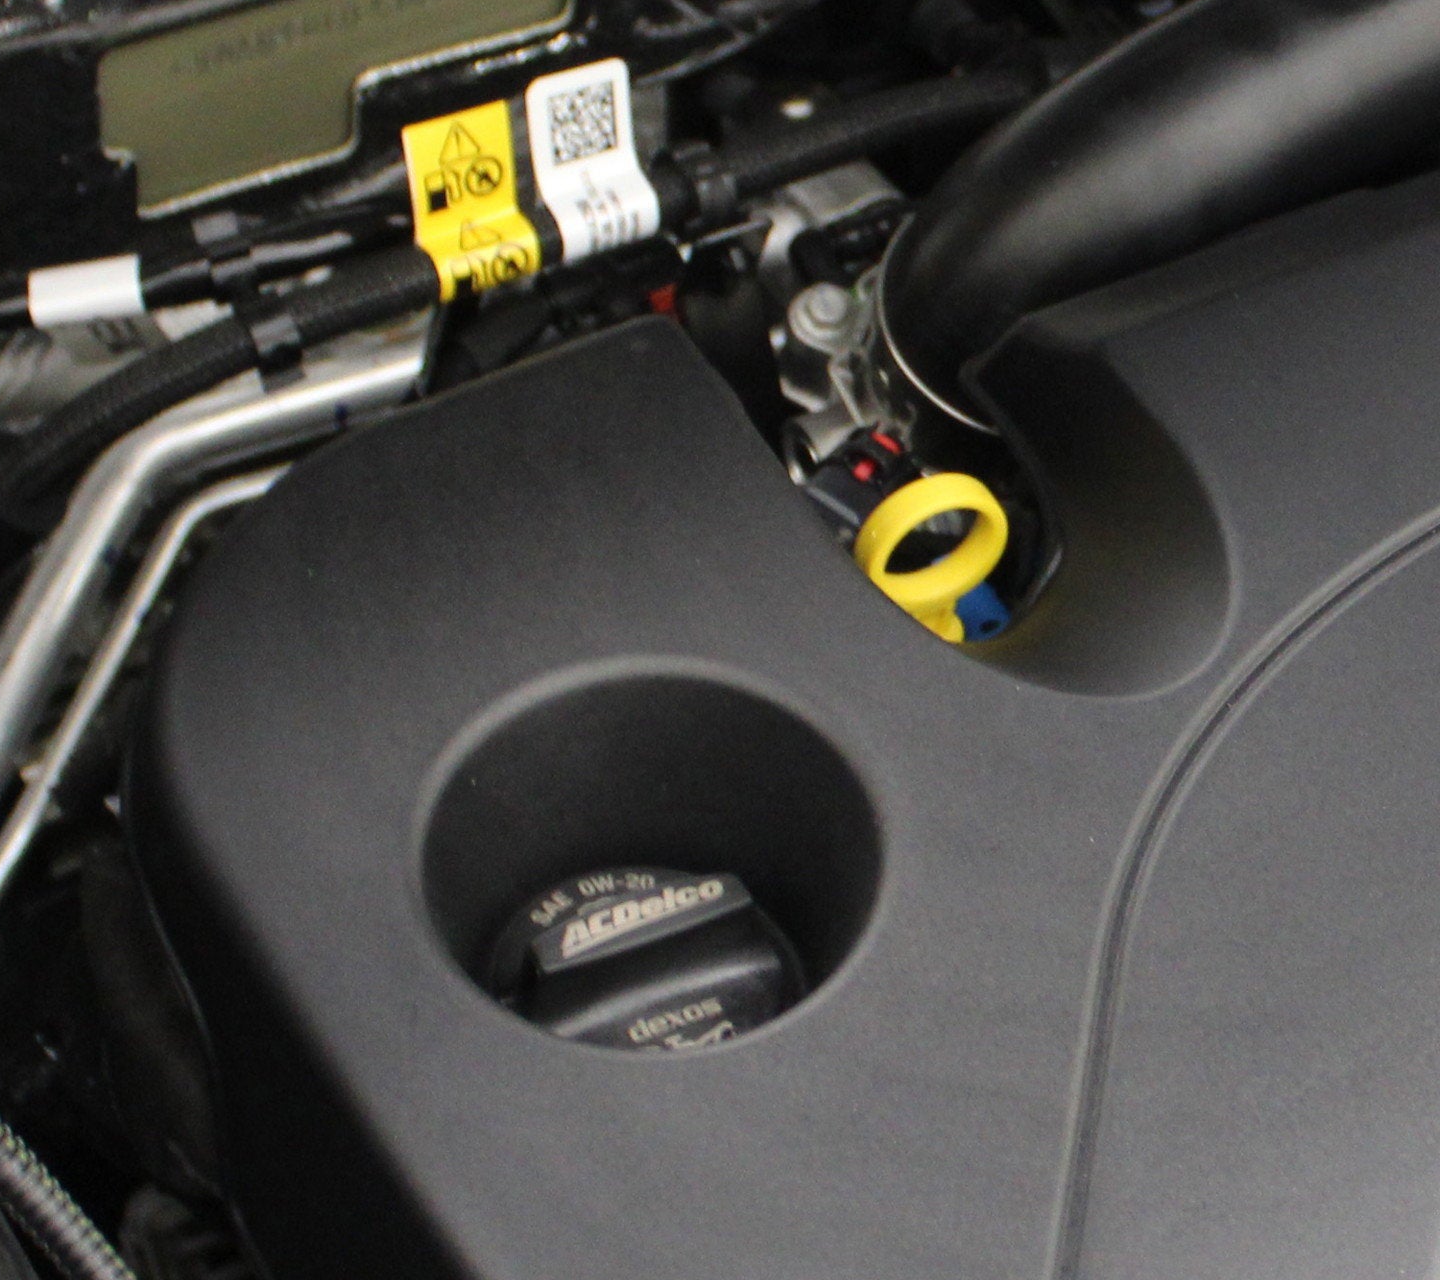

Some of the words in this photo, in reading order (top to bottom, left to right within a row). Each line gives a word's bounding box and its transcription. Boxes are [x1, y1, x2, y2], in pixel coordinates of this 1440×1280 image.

[529, 890, 574, 928] SAE
[561, 878, 725, 960] ACDelco
[626, 996, 723, 1045] dexos
